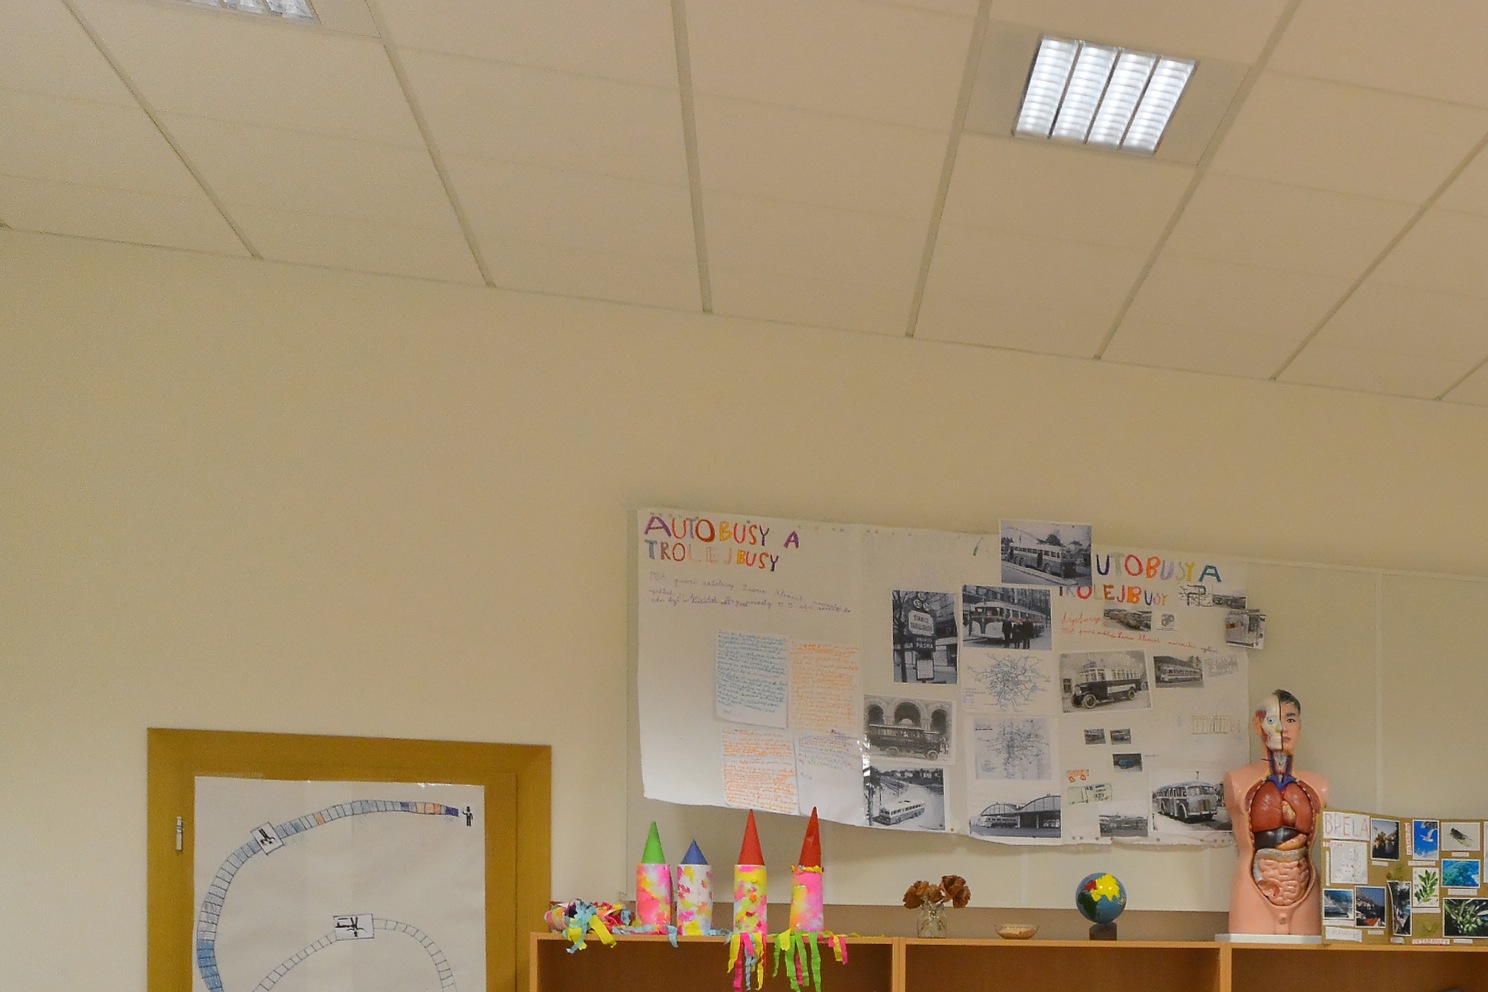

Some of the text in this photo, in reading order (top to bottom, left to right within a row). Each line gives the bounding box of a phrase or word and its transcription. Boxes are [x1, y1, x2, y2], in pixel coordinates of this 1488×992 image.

[644, 515, 800, 549] AUTOBUSY A
[644, 539, 779, 572] TROLEJBUSY
[1096, 552, 1222, 583] UTOBUSY A
